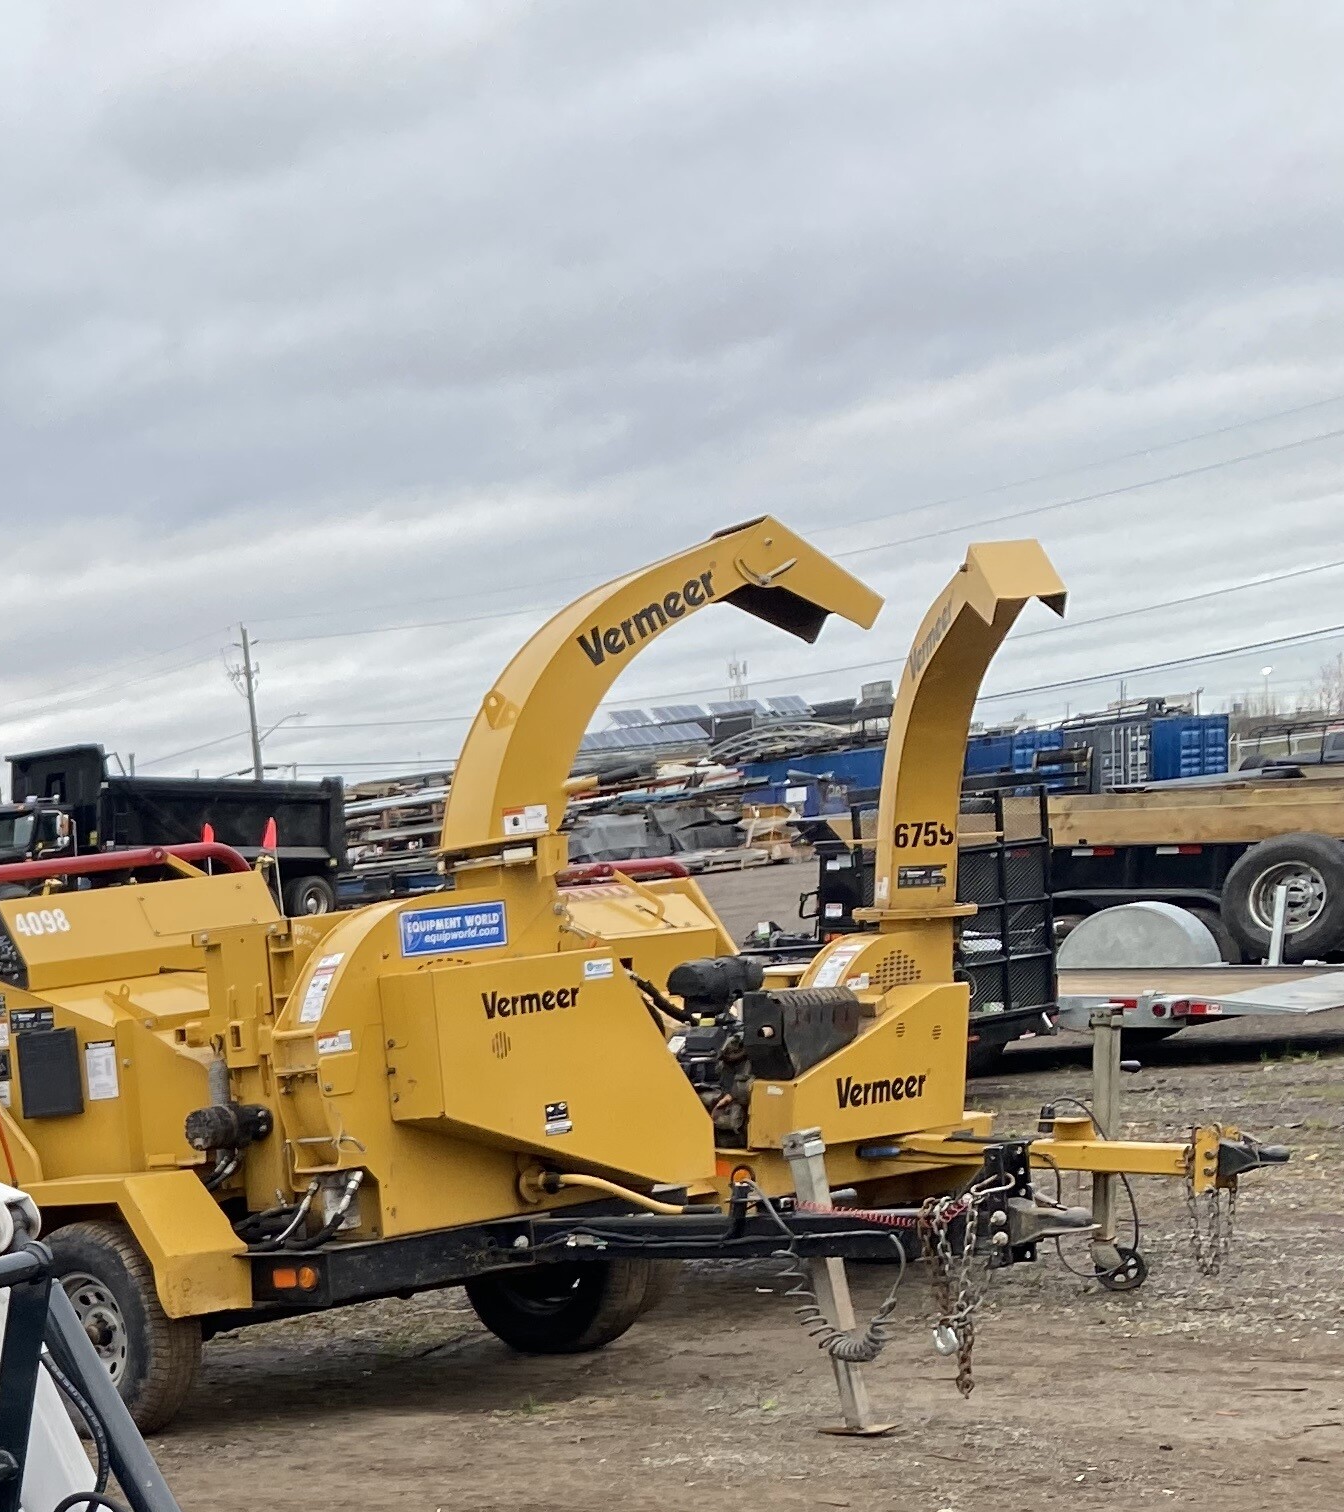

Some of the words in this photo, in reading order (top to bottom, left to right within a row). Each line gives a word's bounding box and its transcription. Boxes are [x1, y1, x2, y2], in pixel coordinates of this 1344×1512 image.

[576, 570, 716, 667] Vermeer
[15, 908, 71, 937] 4098
[406, 916, 462, 933] EQUIPMENT
[465, 912, 501, 927] WORLD
[424, 926, 500, 944] equipworld.com
[481, 987, 580, 1019] Vermeer
[835, 1074, 927, 1109] Vermeer
